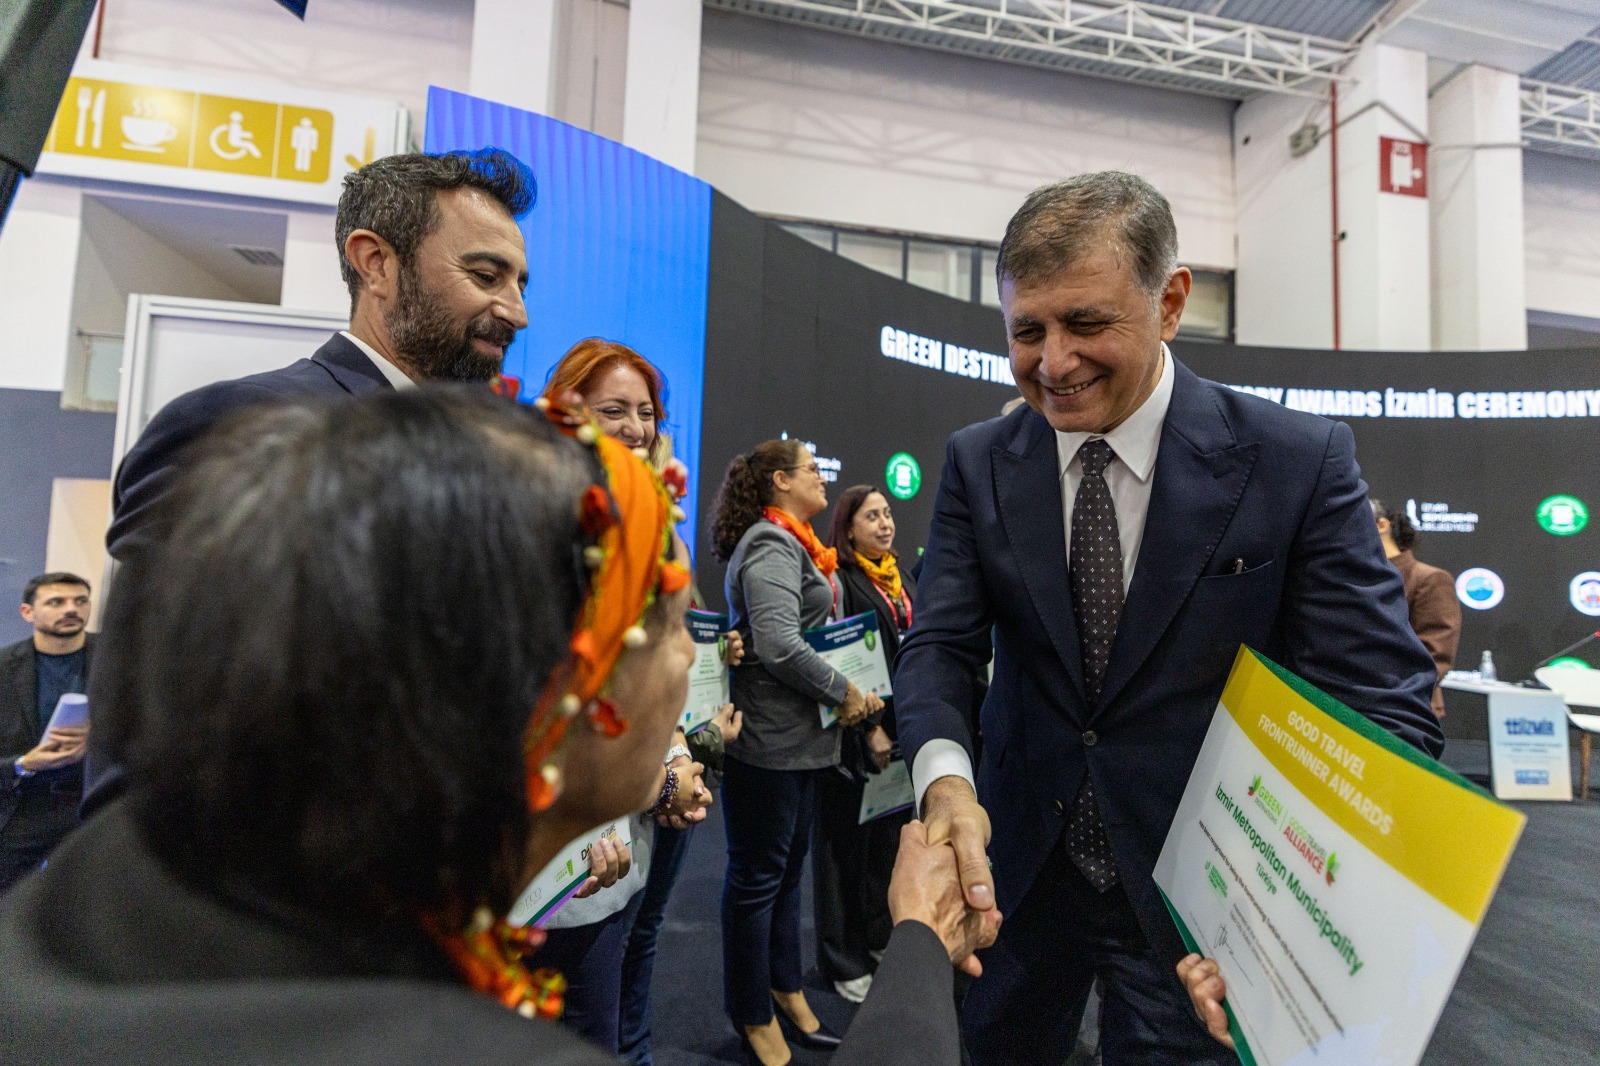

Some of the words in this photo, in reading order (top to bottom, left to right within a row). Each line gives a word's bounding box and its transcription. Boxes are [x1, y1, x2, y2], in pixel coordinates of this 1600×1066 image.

[880, 325, 943, 370] GREEN
[944, 343, 1017, 387] DESTIN
[1285, 388, 1383, 418] AWARDS
[1457, 389, 1600, 419] CEREMONY
[1258, 714, 1330, 783] FRONTRUNNER
[1328, 773, 1393, 836] AWARDS
[1287, 710, 1321, 743] GOOD
[1319, 733, 1366, 781] TRAVEL
[1258, 785, 1284, 817] GREEN
[1215, 781, 1235, 812] İzmir
[1232, 805, 1289, 882] Metropolitan
[1286, 871, 1364, 977] Municipality
[1255, 862, 1278, 896] Türkiye
[1283, 826, 1324, 875] ALLIANCE
